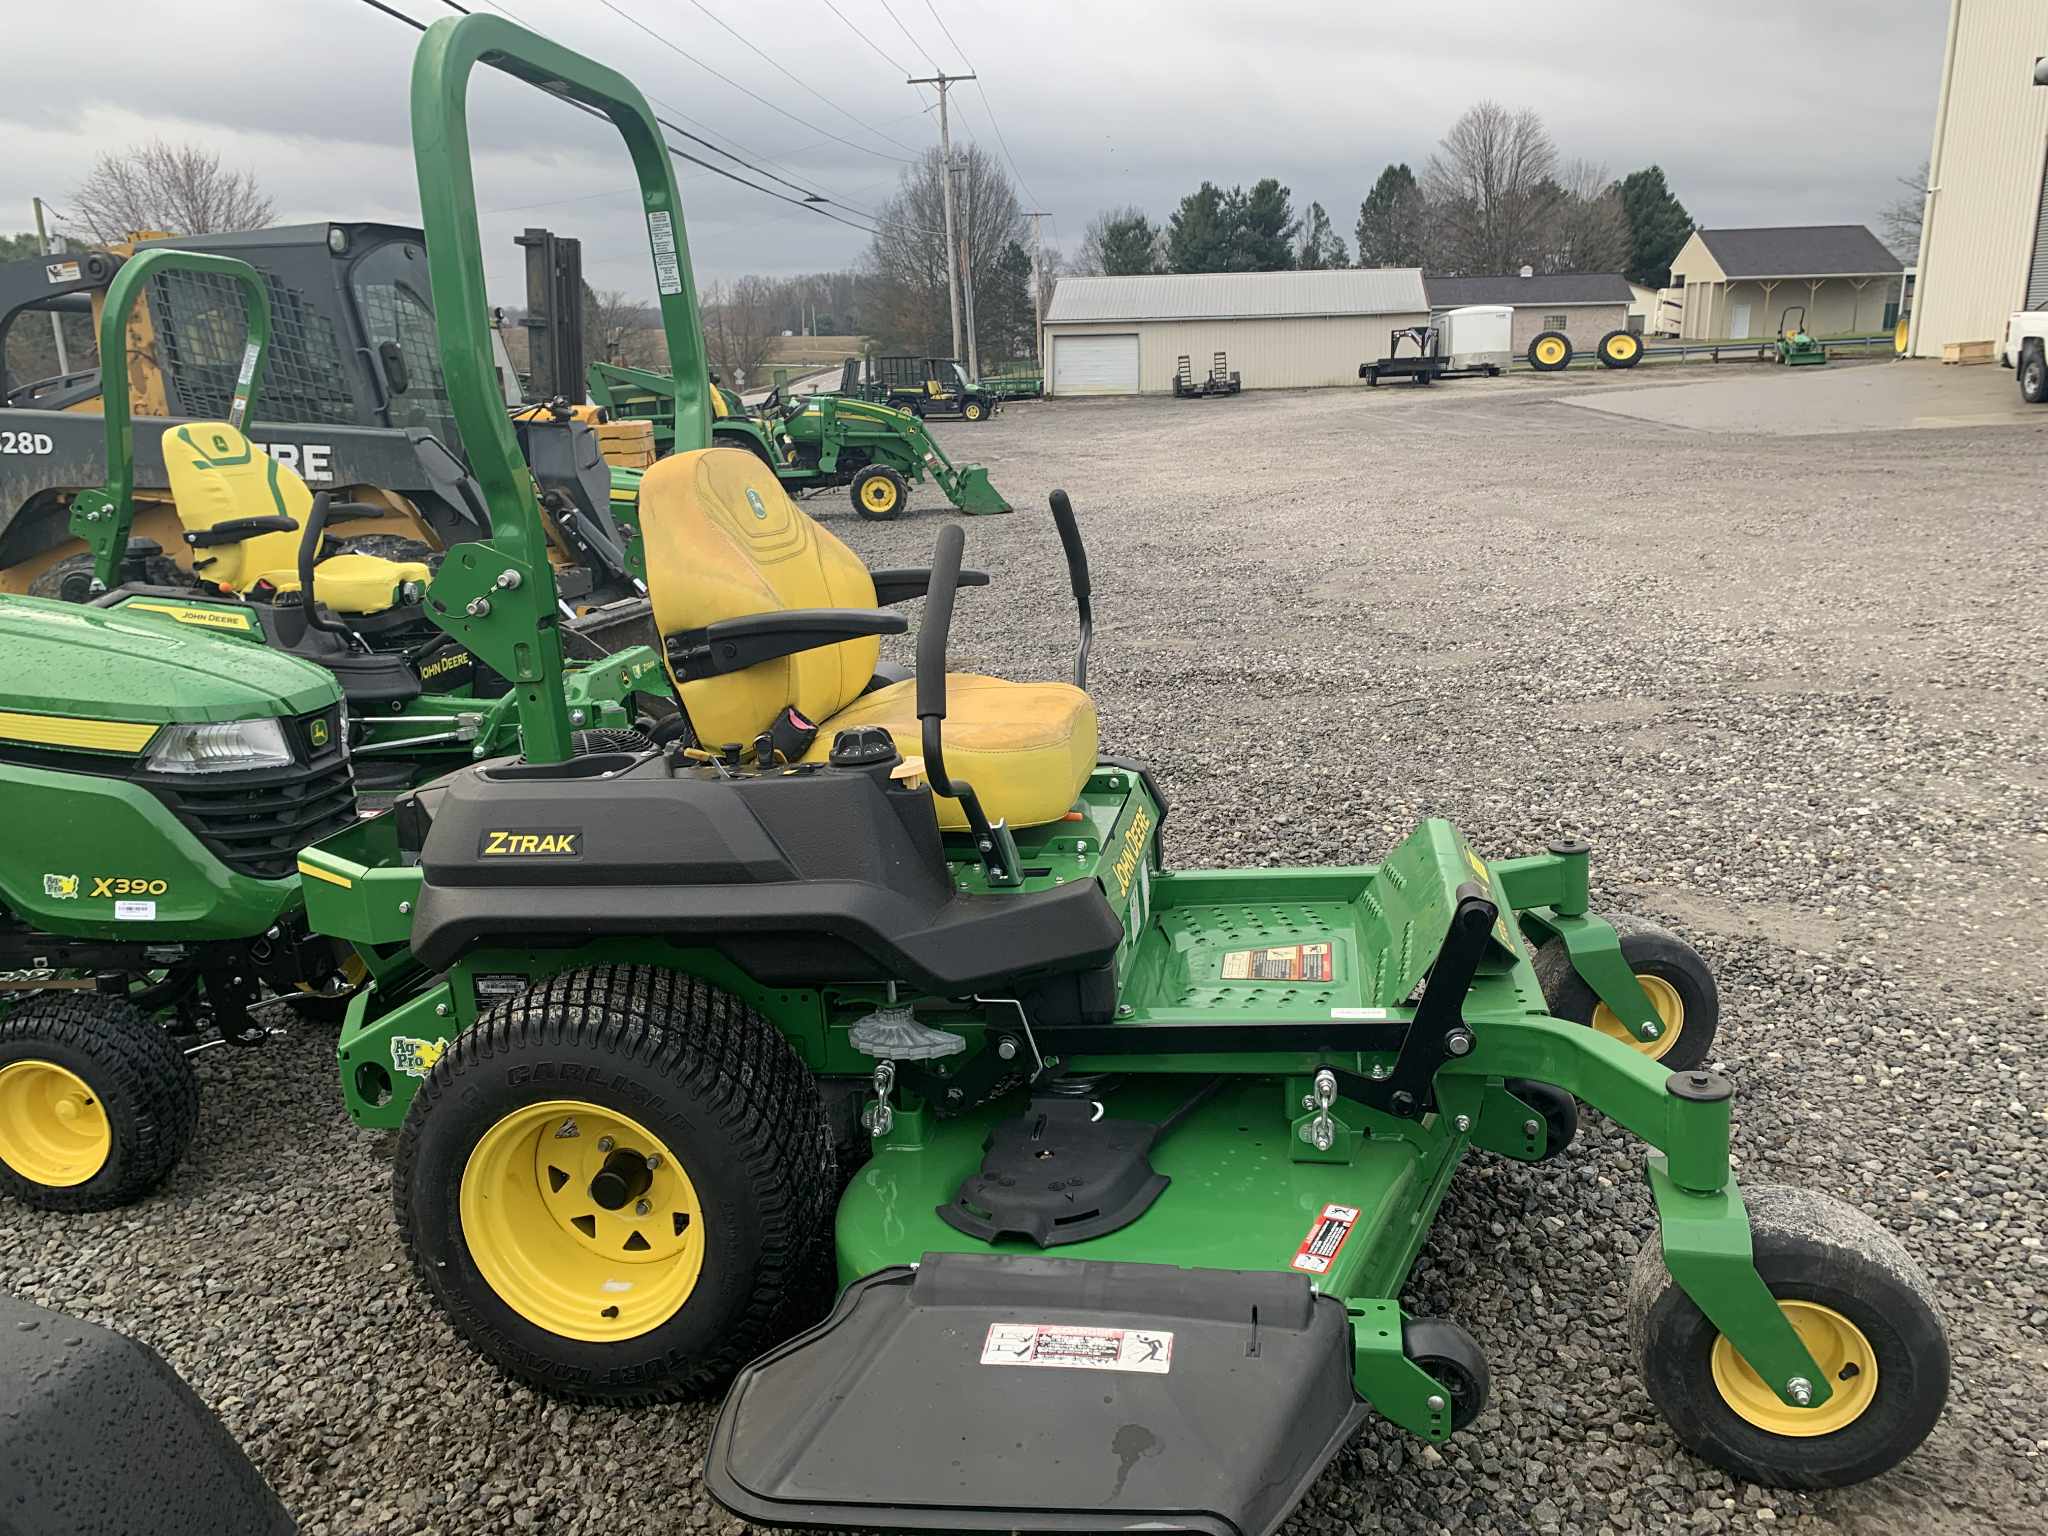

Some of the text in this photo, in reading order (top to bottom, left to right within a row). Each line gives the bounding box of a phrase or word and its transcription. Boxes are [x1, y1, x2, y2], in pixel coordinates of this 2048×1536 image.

[0, 431, 53, 455] 28D
[181, 611, 240, 625] JOHN DEERE
[441, 652, 470, 672] DEERE
[484, 831, 576, 854] ZTRAK
[1112, 805, 1151, 898] JOHN DEERE
[89, 877, 168, 898] X390
[396, 1054, 424, 1068] Pro
